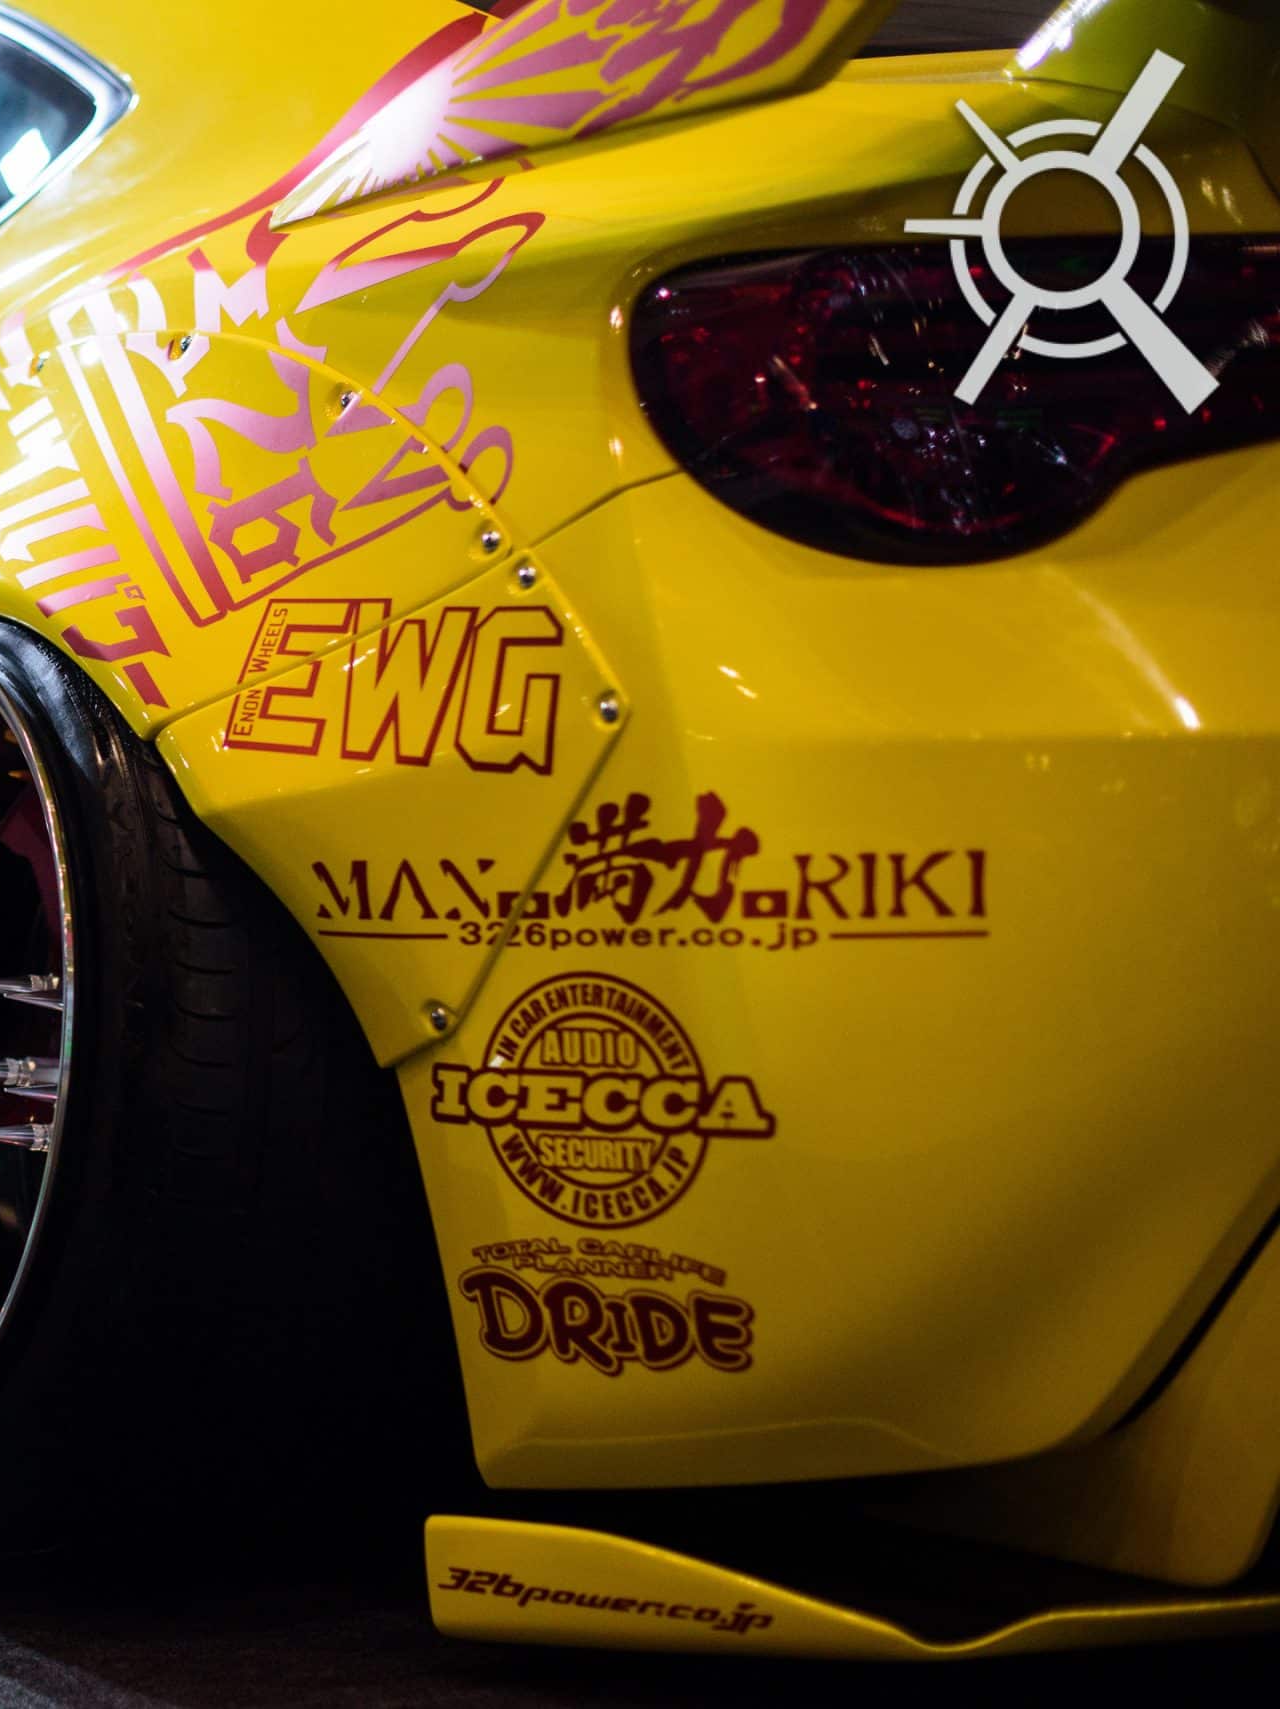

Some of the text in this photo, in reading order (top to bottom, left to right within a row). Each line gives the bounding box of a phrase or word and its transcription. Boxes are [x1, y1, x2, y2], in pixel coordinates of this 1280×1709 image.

[224, 598, 564, 776] EWG
[232, 607, 289, 738] ENON WHEELS
[312, 858, 495, 921] MAN
[793, 849, 987, 920] RIKI
[459, 921, 819, 951] 326power.co.jp
[495, 982, 693, 1072] IN CAR ENTERTAINMENT
[540, 1027, 640, 1069] AUDIO
[432, 1062, 777, 1139] ICECCA
[501, 1132, 691, 1221] WWW.ICECCA.JP
[537, 1134, 657, 1174] SECURITY
[471, 1236, 572, 1264] TOTAL
[512, 1252, 674, 1281] PLANNER
